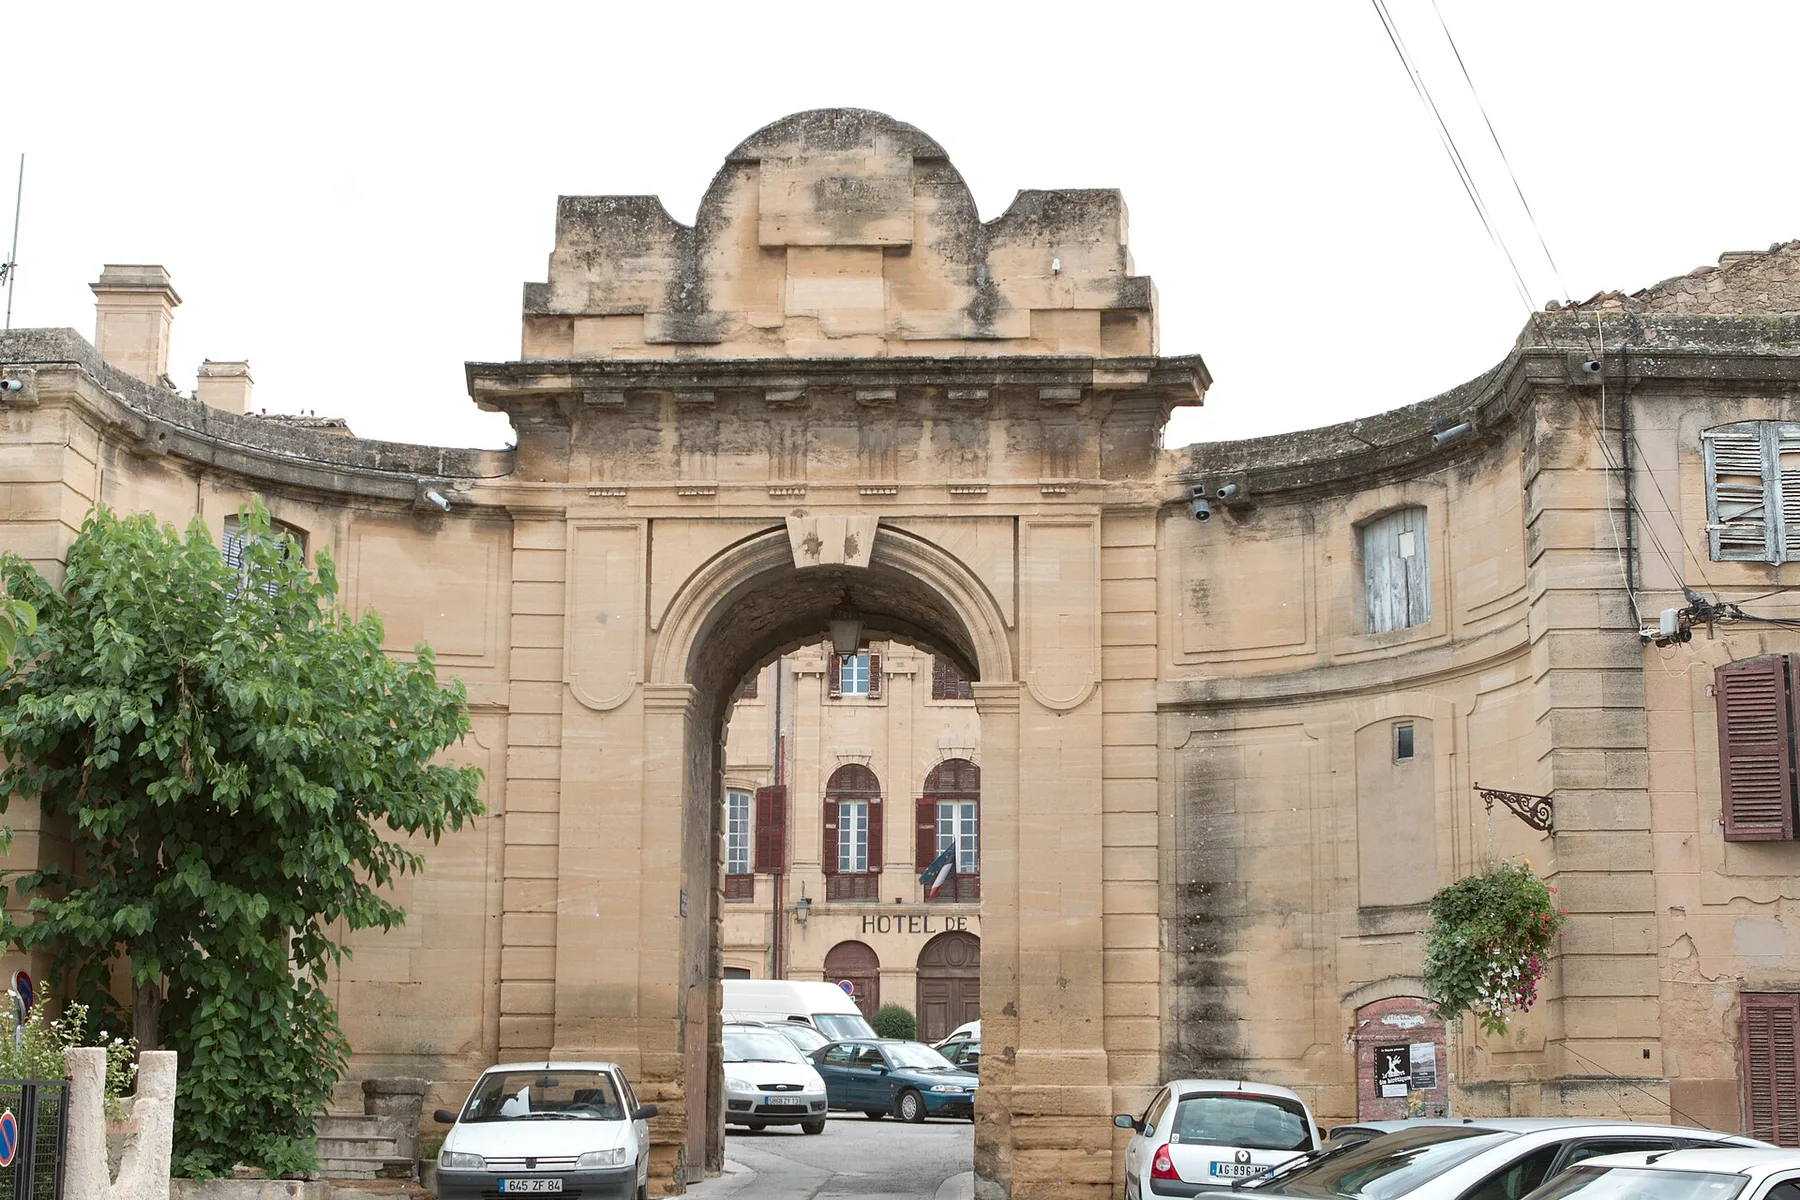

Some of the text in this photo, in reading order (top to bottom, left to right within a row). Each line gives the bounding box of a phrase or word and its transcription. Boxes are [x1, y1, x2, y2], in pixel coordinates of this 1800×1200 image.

[862, 915, 936, 934] HOTEL
[945, 917, 968, 931] DE
[509, 1180, 561, 1191] 645 ZF 84
